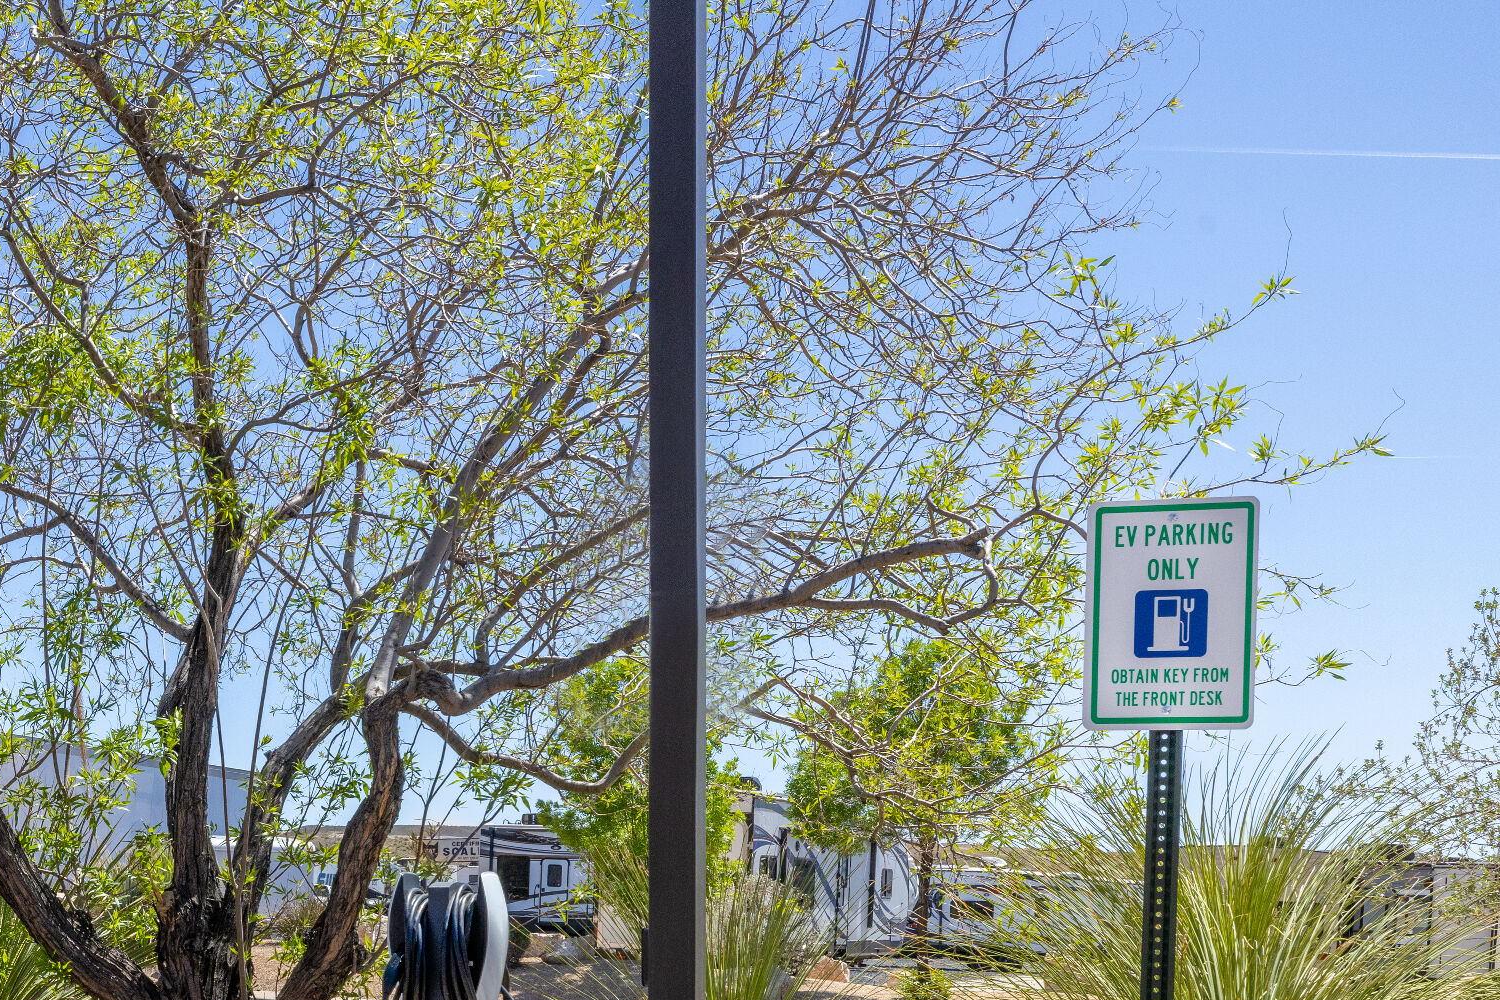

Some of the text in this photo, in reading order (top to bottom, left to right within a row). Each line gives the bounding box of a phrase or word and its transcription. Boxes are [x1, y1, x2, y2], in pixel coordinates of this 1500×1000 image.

[1115, 522, 1233, 547] EV PARKING
[1148, 558, 1199, 580] ONLY
[1111, 668, 1229, 684] OBTAIN KEY FROM
[1116, 690, 1222, 706] THE FRONT DESK
[443, 847, 479, 856] SCAL
